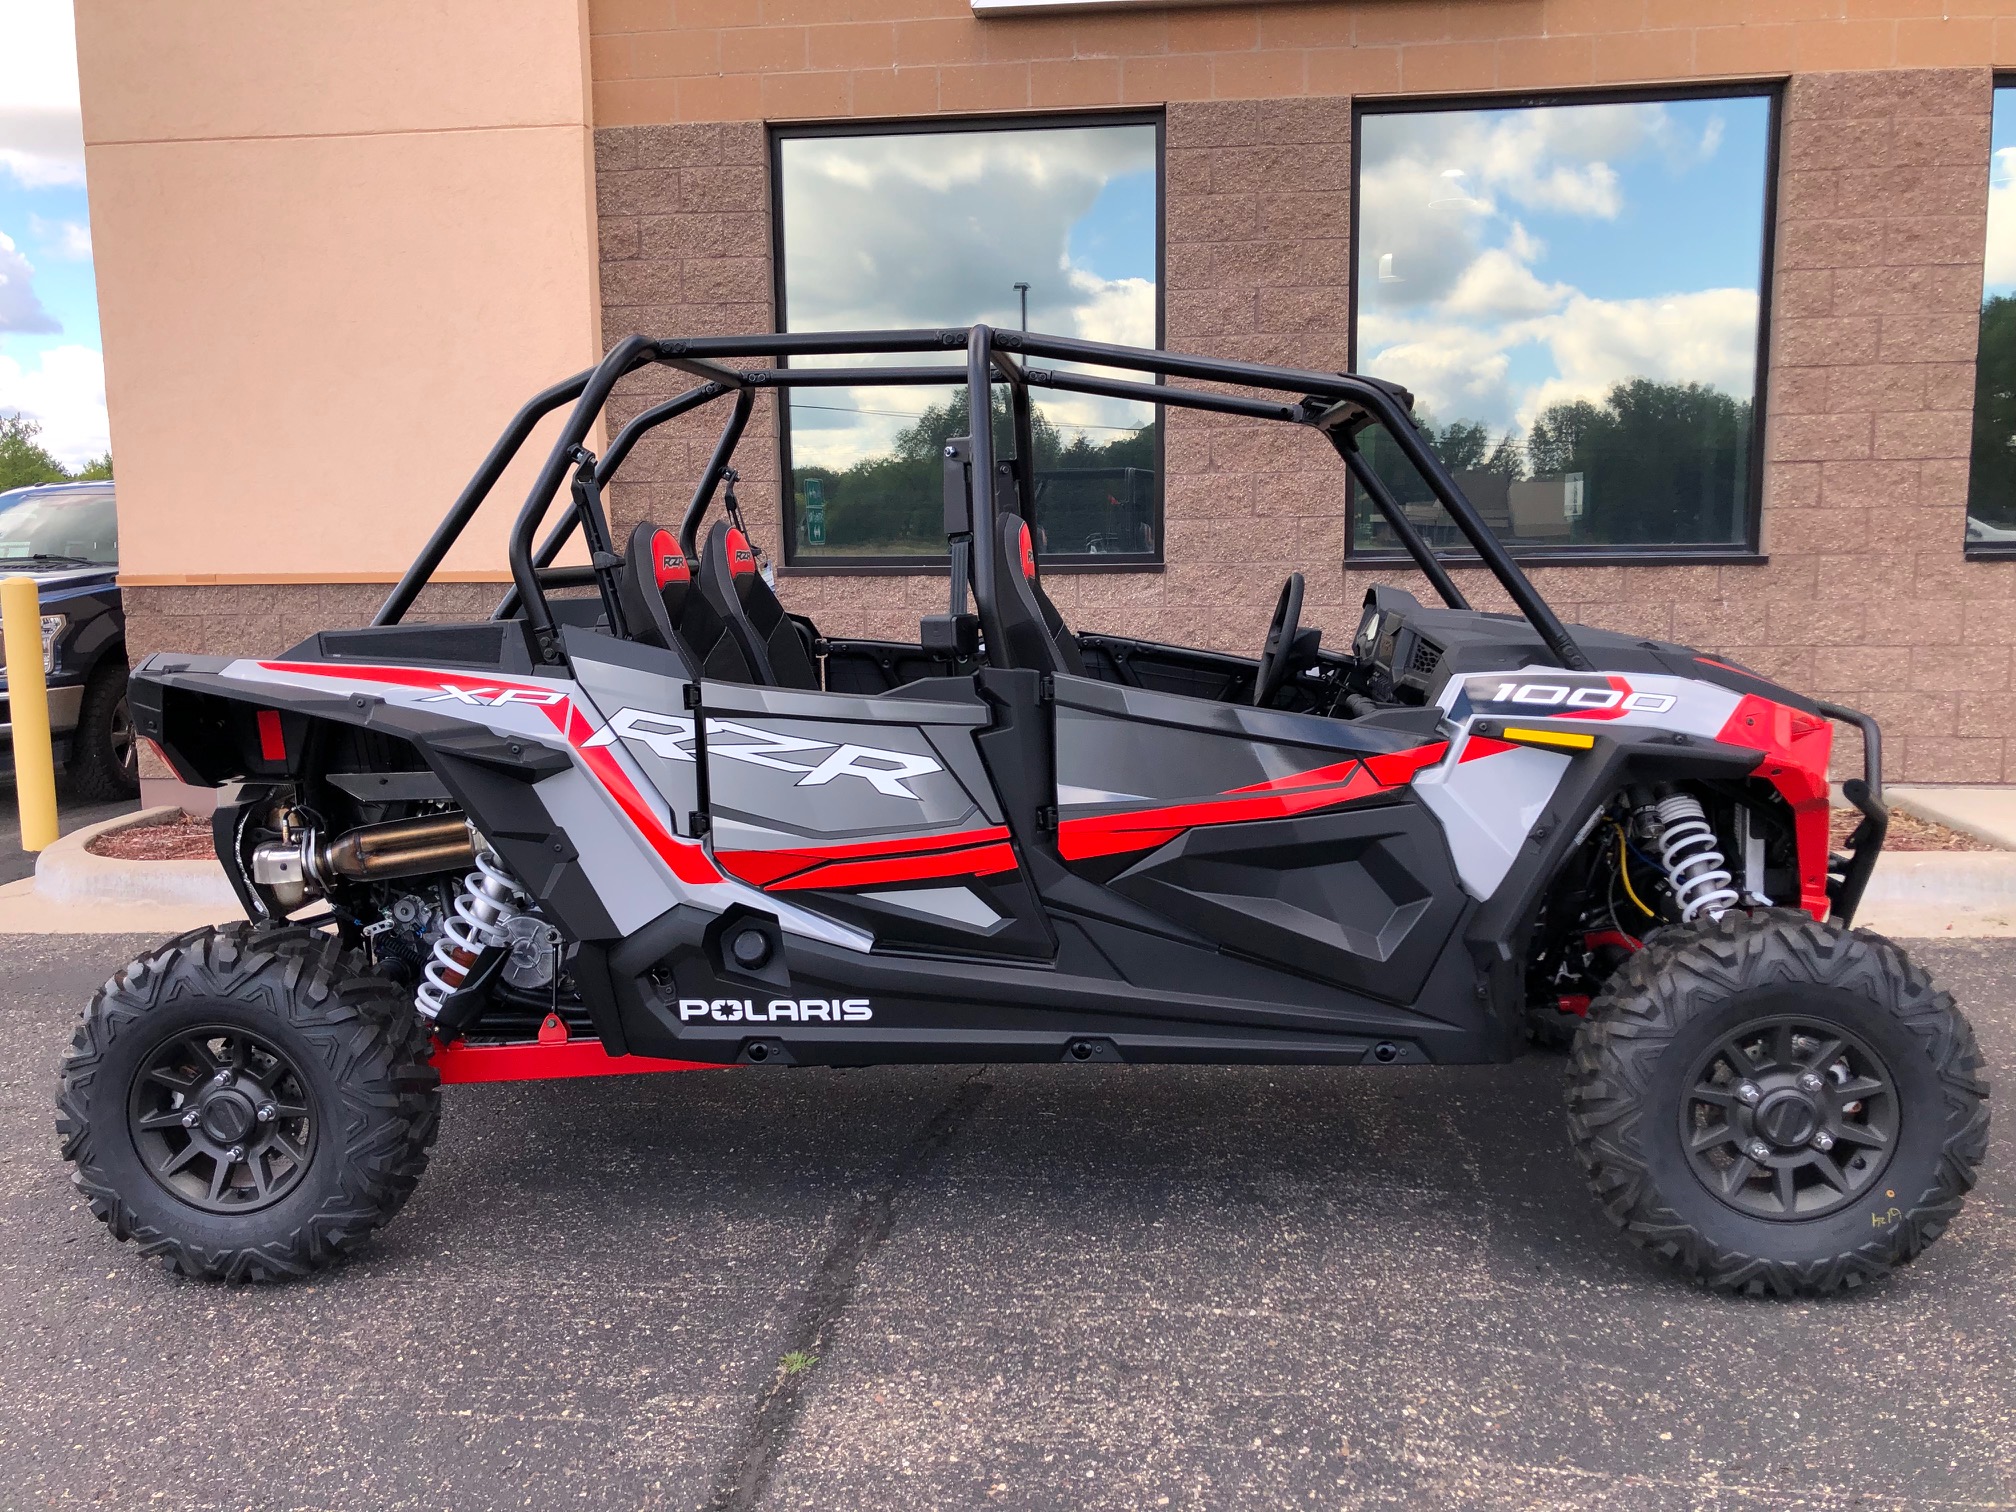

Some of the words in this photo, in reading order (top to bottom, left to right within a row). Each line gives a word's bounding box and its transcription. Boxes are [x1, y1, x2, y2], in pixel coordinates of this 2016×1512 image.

[663, 554, 685, 570] RZR
[416, 683, 569, 706] XP
[1492, 683, 1678, 713] 1000
[579, 706, 944, 801] RZR
[678, 999, 873, 1022] POLARIS
